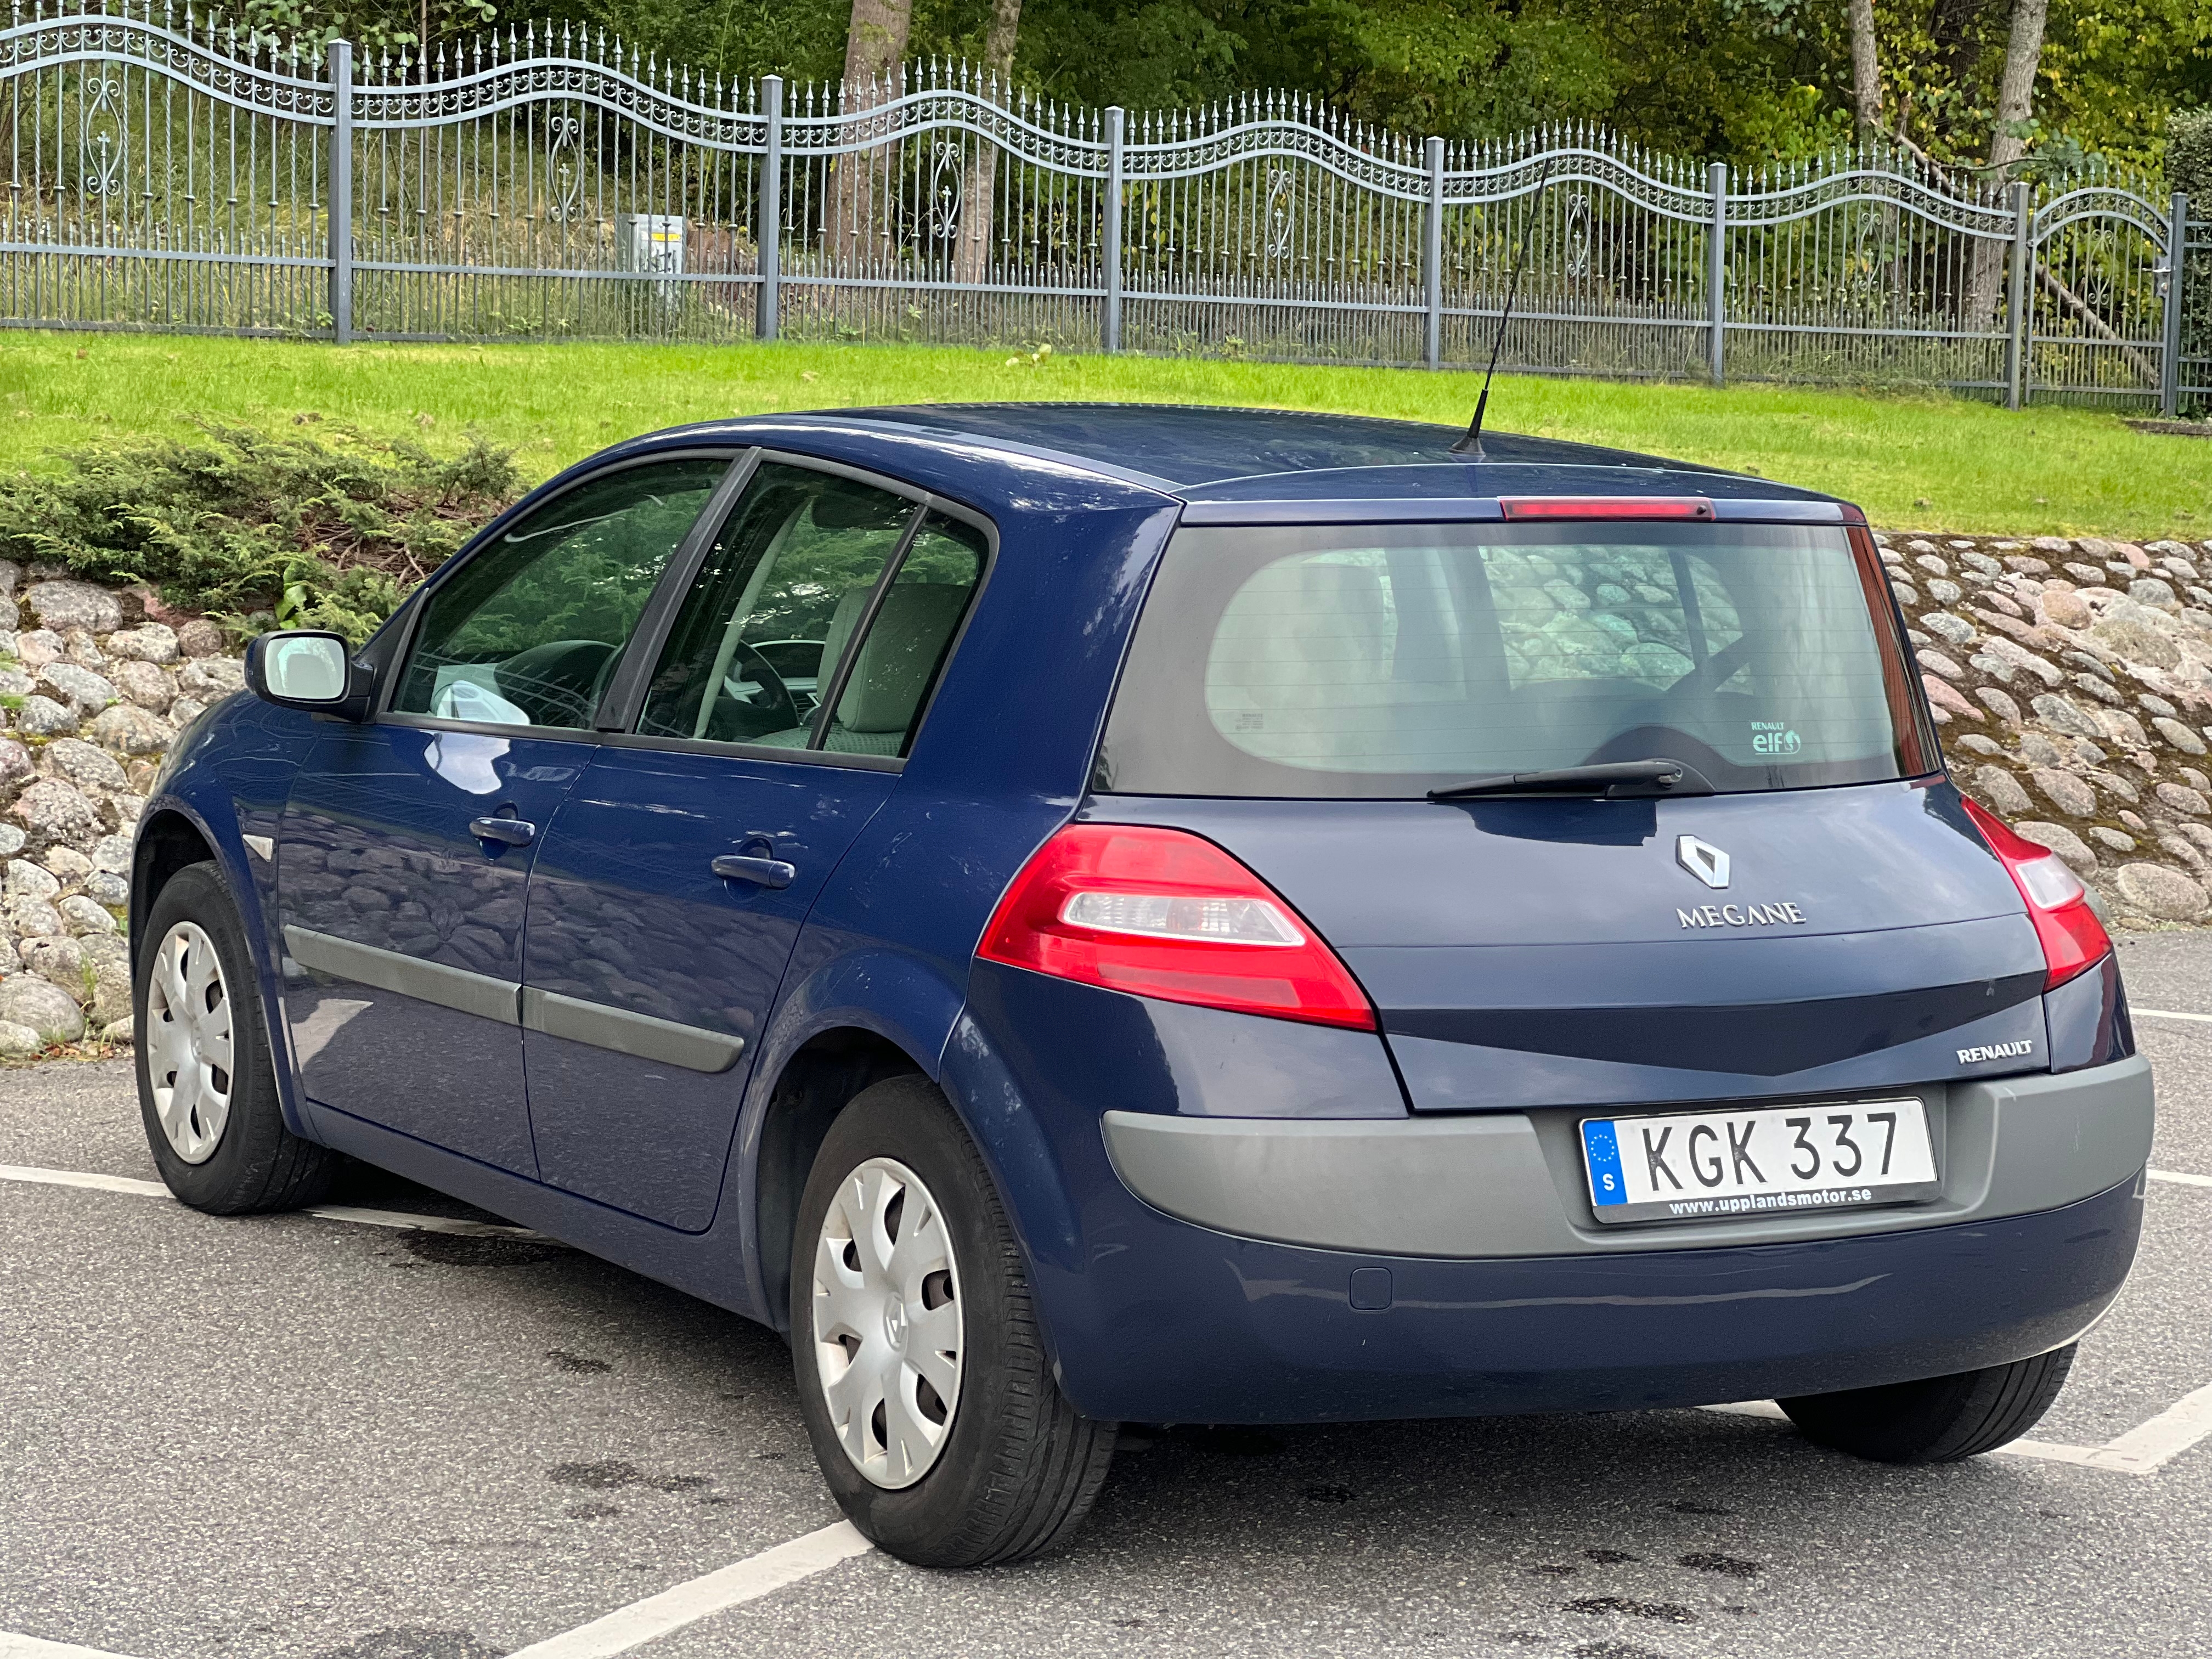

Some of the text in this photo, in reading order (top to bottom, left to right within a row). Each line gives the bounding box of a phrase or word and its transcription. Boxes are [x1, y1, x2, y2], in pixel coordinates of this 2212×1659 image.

[1751, 722, 1784, 730] RENAULT
[1753, 732, 1782, 752] elf
[1676, 902, 1807, 929] MEGANE
[1956, 1040, 2032, 1064] RENAULT
[1643, 1112, 1897, 1191] KGK 337
[1602, 1173, 1615, 1191] S
[1669, 1189, 1871, 1214] www.upplandsmotor.se
